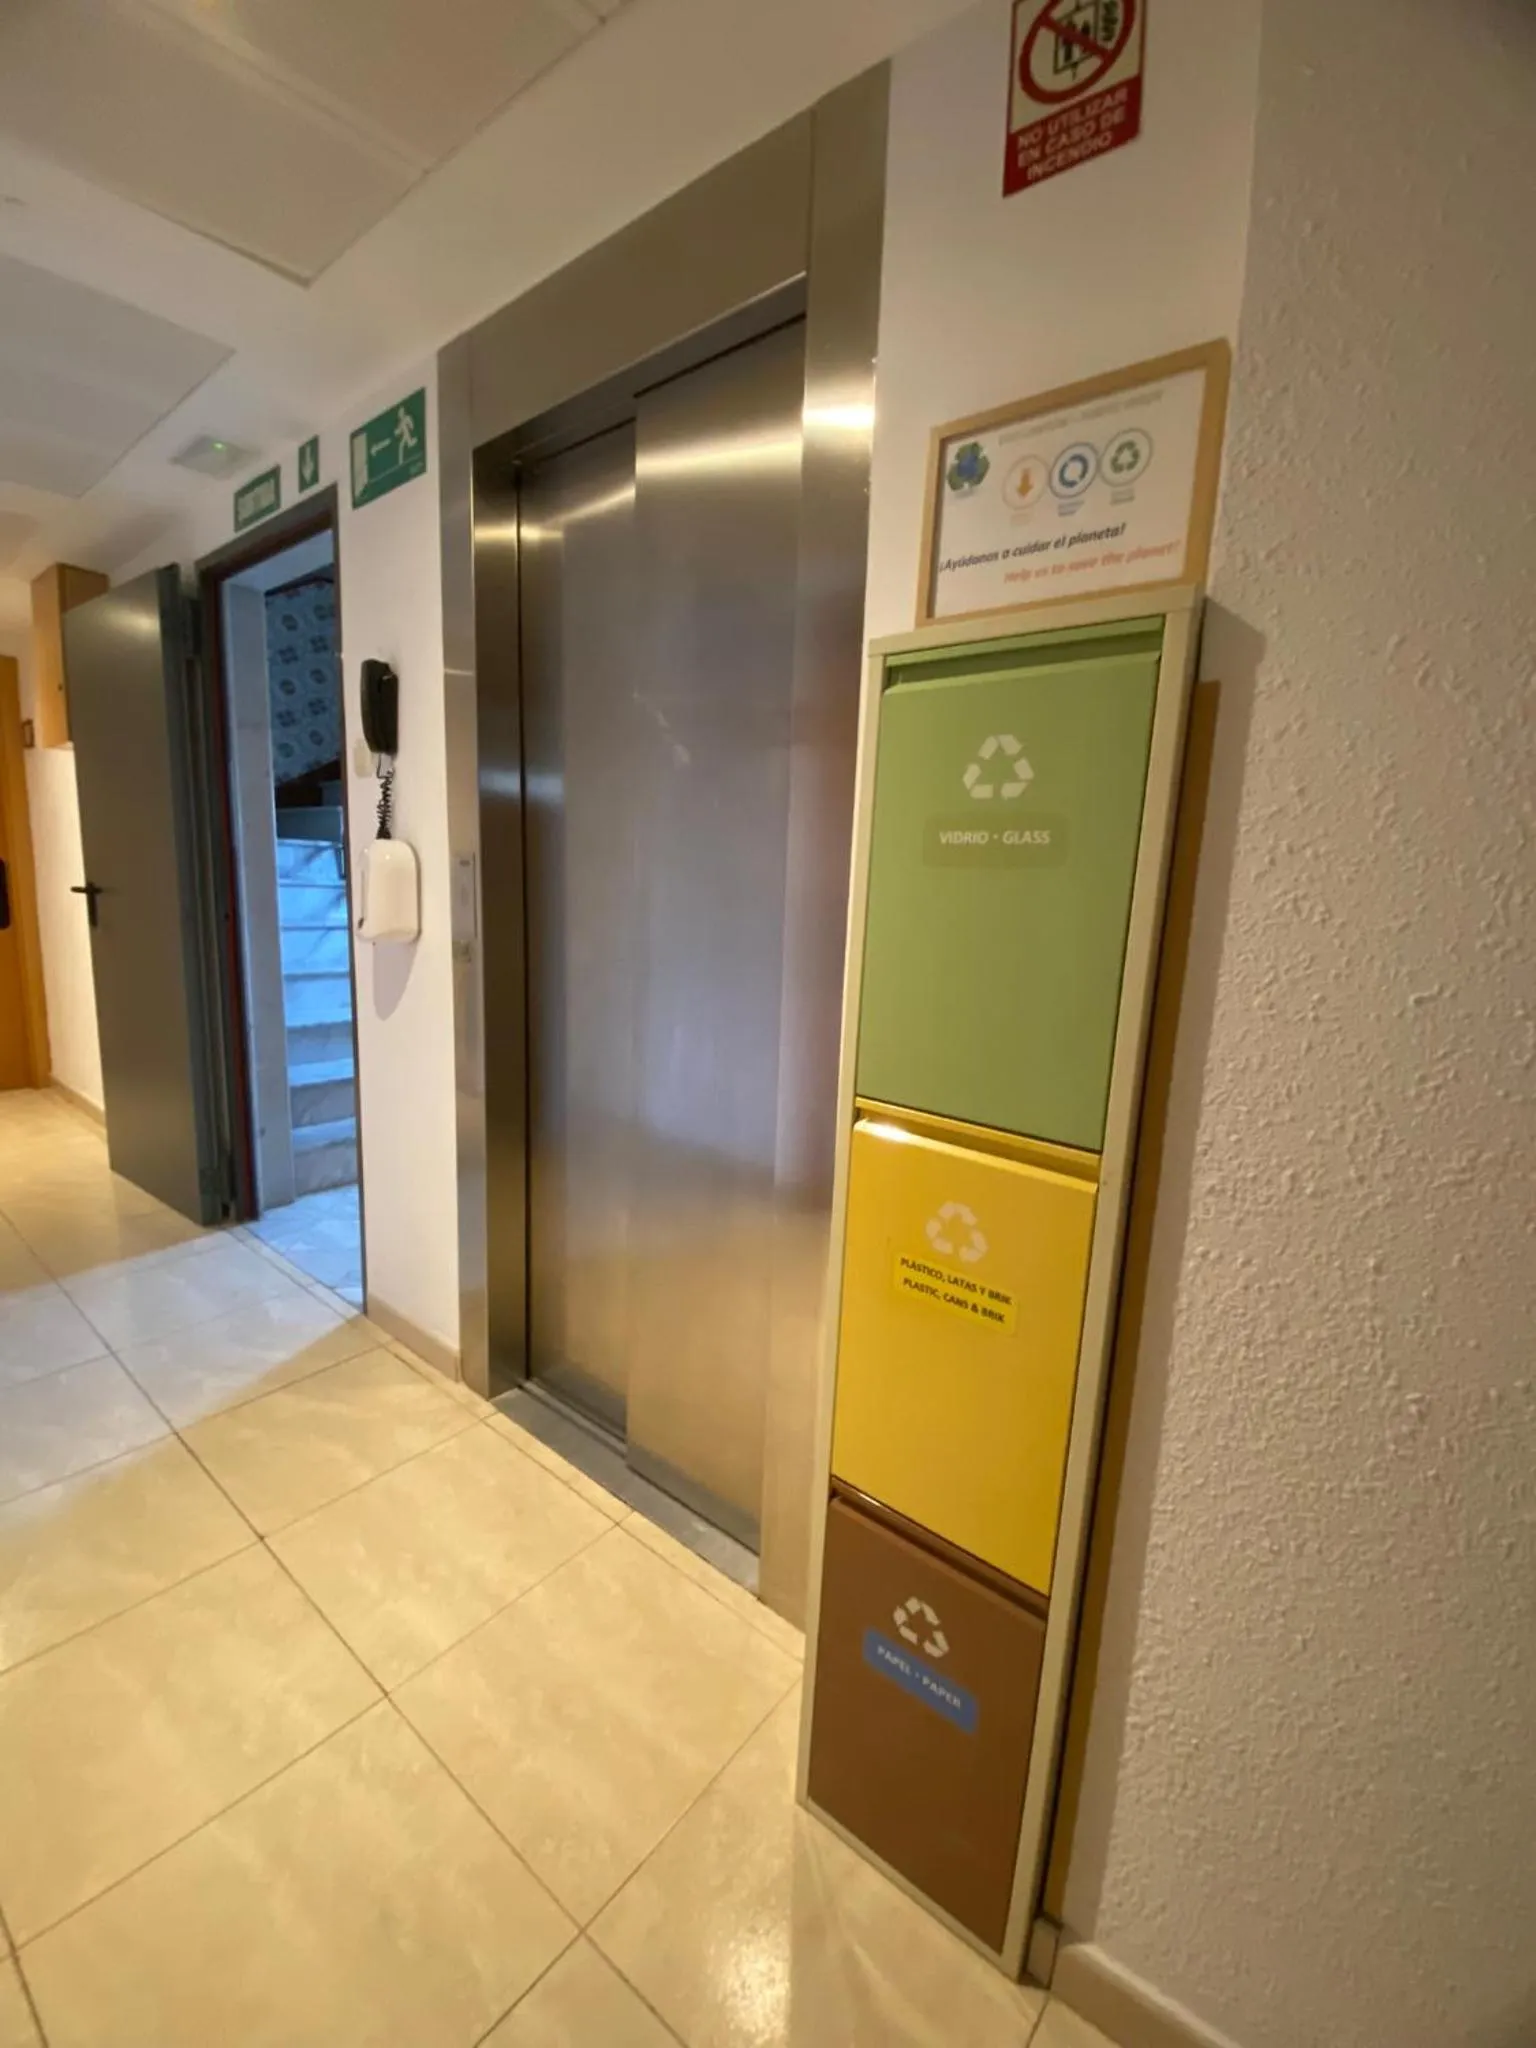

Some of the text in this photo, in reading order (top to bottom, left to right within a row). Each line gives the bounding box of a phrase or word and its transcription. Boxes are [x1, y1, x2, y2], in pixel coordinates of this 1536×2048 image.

[1018, 127, 1043, 148] NO
[1045, 122, 1097, 151] CASO
[1012, 541, 1051, 557] cuidar
[1053, 536, 1066, 549] el
[1067, 522, 1126, 549] planeta!
[1004, 567, 1031, 584] Help
[1101, 551, 1125, 567] the
[939, 831, 989, 845] VIDRIO
[1002, 830, 1051, 845] GLASS
[947, 1275, 978, 1293] LATAS
[943, 1292, 969, 1309] CANS
[877, 1645, 911, 1675] PAPEL
[922, 1676, 961, 1709] PAPER
